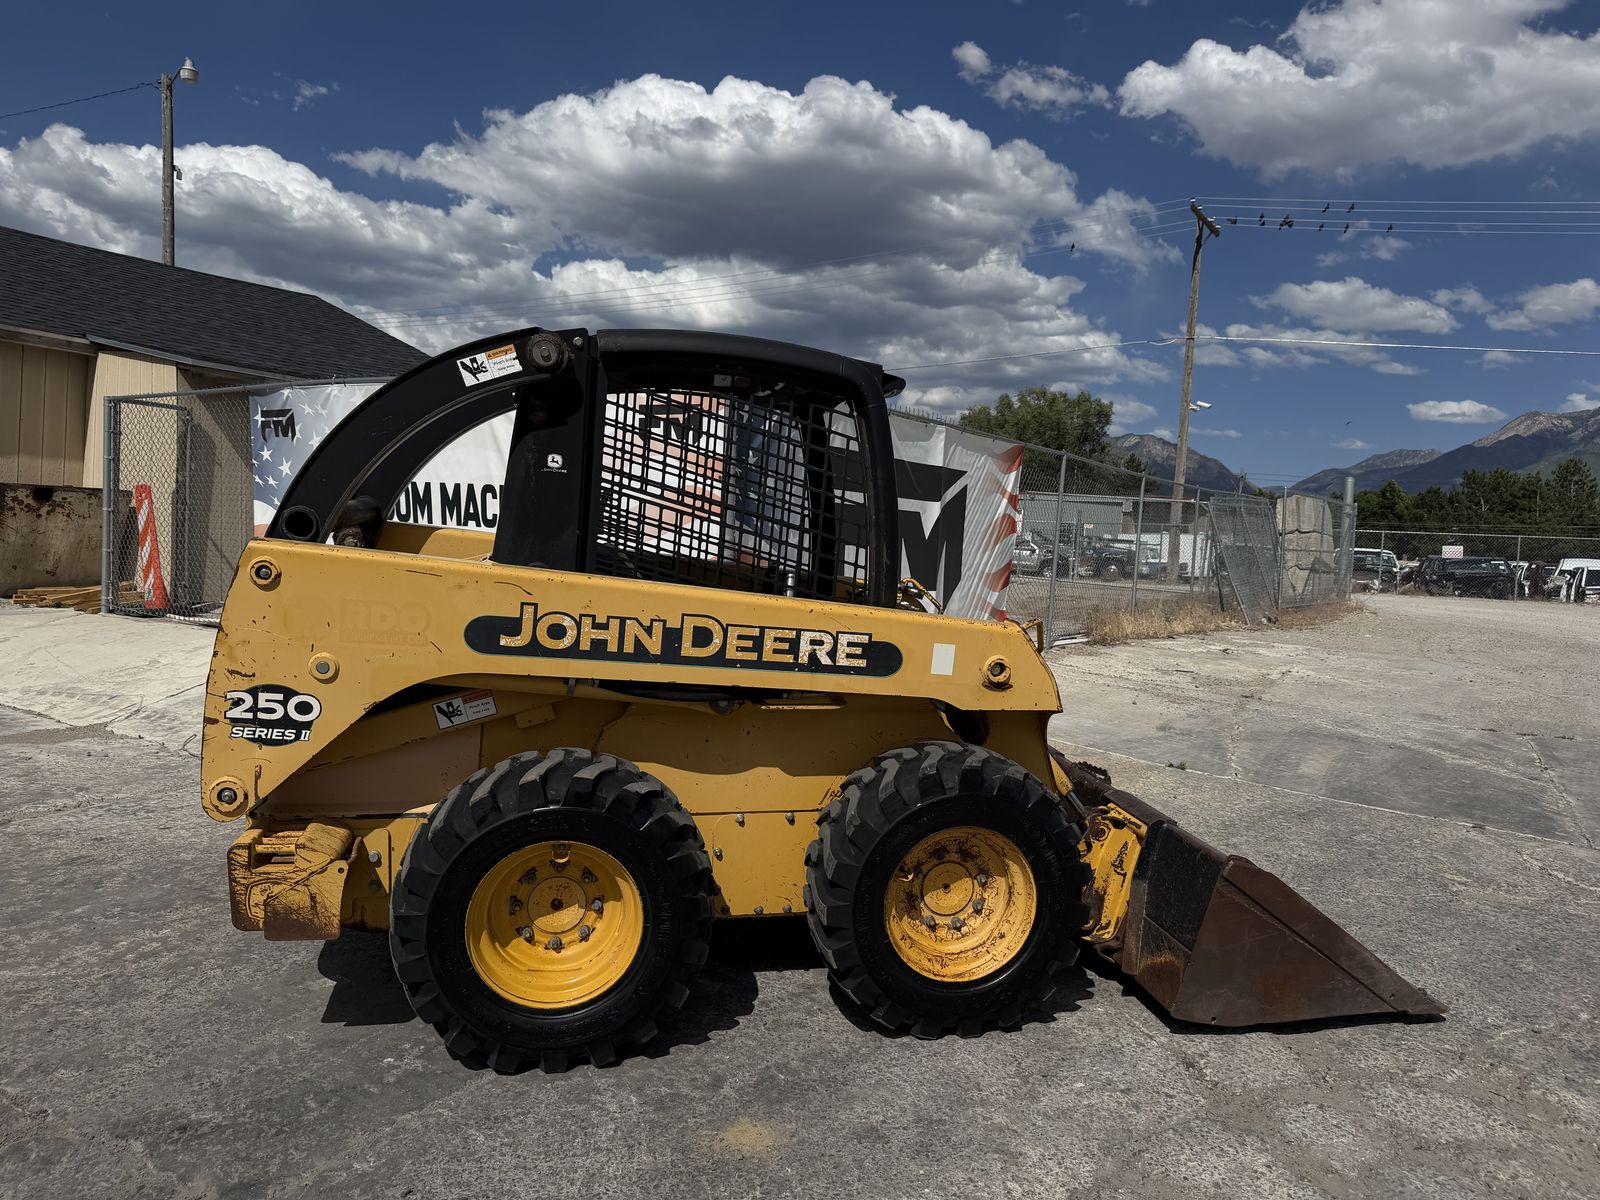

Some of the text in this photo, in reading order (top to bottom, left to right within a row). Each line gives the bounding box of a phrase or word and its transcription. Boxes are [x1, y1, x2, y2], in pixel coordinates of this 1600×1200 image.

[387, 482, 504, 528] OM MAC
[500, 604, 870, 667] JOHN DEERE
[225, 691, 321, 722] 250
[231, 727, 297, 740] SERIES
